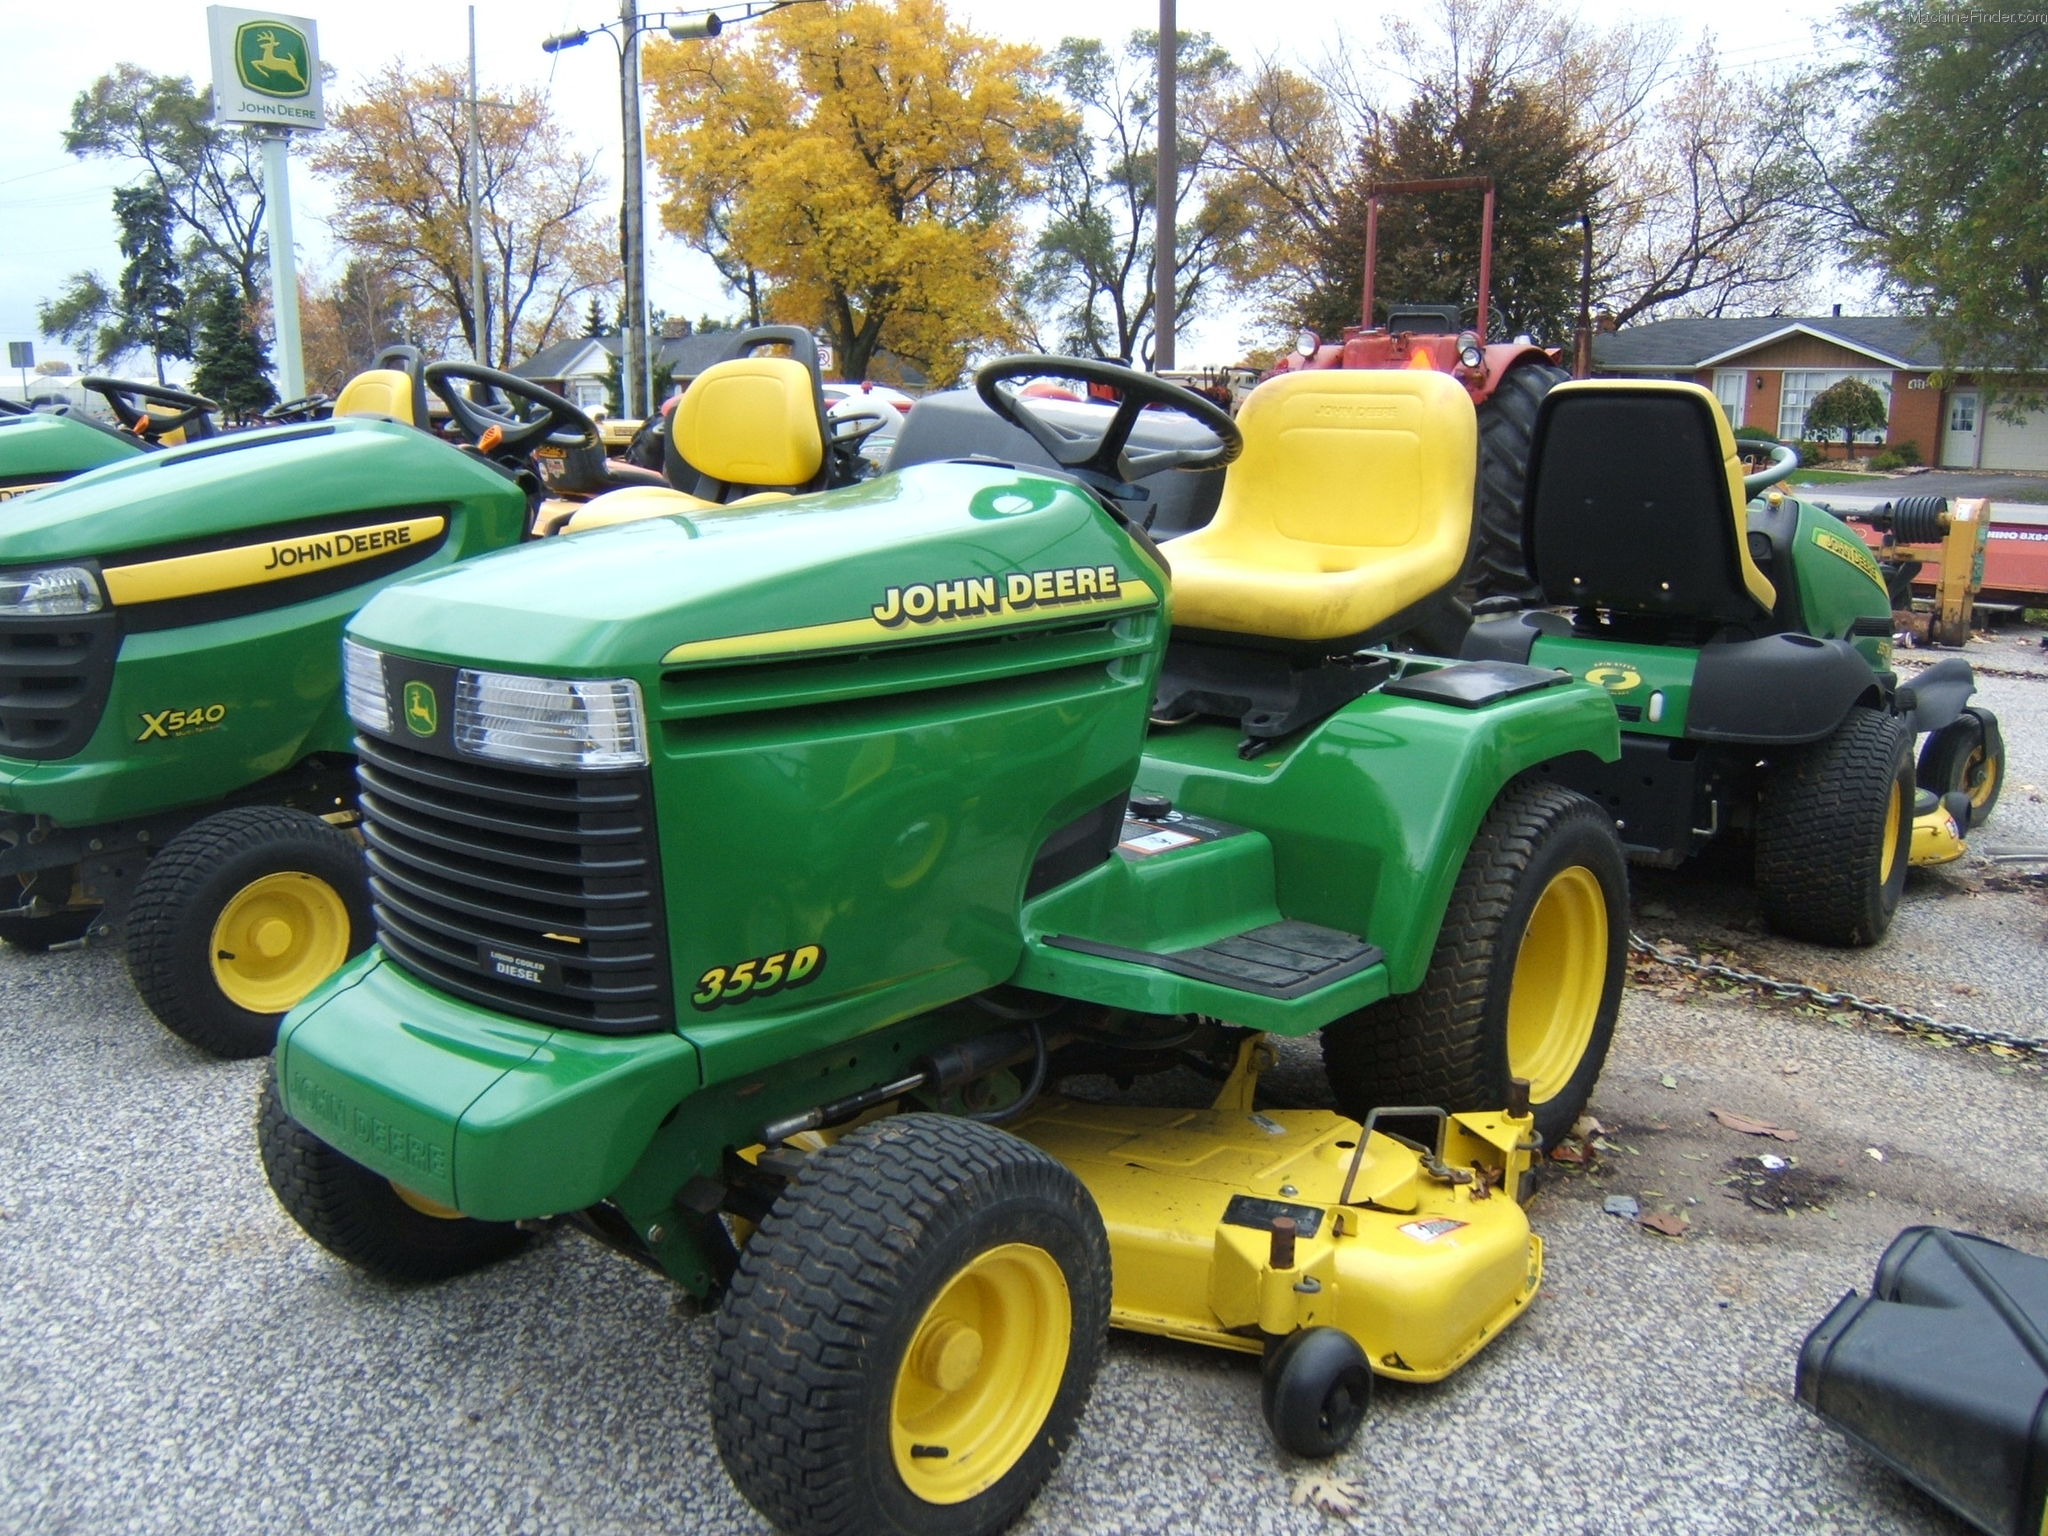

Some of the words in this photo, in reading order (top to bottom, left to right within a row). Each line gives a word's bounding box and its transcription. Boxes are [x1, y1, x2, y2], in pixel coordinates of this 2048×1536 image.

[238, 102, 276, 114] JOHN
[277, 104, 316, 119] DEERE
[265, 541, 332, 570] JOHN
[335, 526, 411, 556] DEERE
[1987, 531, 2018, 539] HINO
[872, 576, 1002, 628] JOHN
[1006, 565, 1121, 613] DEERE
[136, 703, 226, 742] X540
[496, 962, 542, 983] DIESEL
[692, 944, 825, 1011] 355D
[353, 1107, 447, 1179] DEERE
